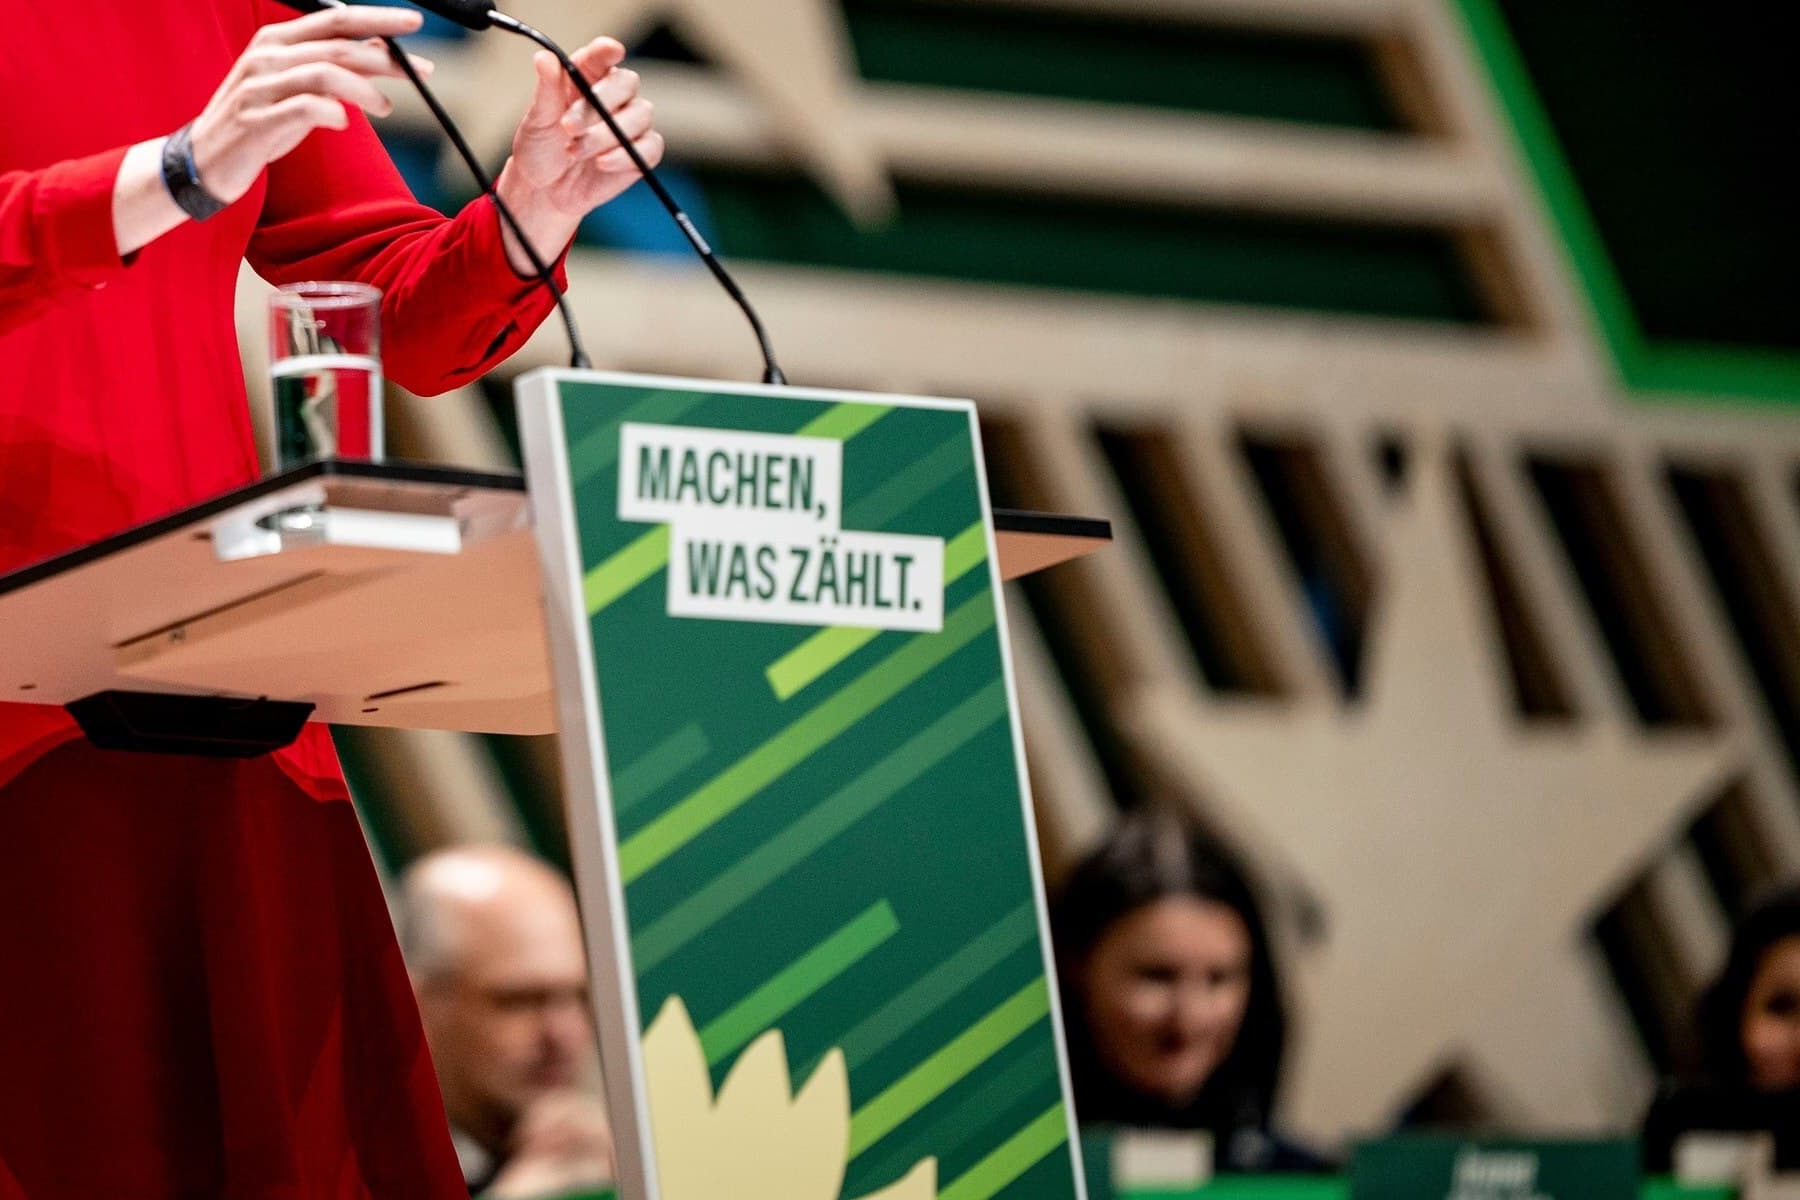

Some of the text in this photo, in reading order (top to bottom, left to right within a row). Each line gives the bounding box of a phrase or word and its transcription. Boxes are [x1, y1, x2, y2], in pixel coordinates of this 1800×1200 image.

[636, 443, 827, 519] MACHEN,
[687, 535, 922, 612] WAS ZÄHLT.
